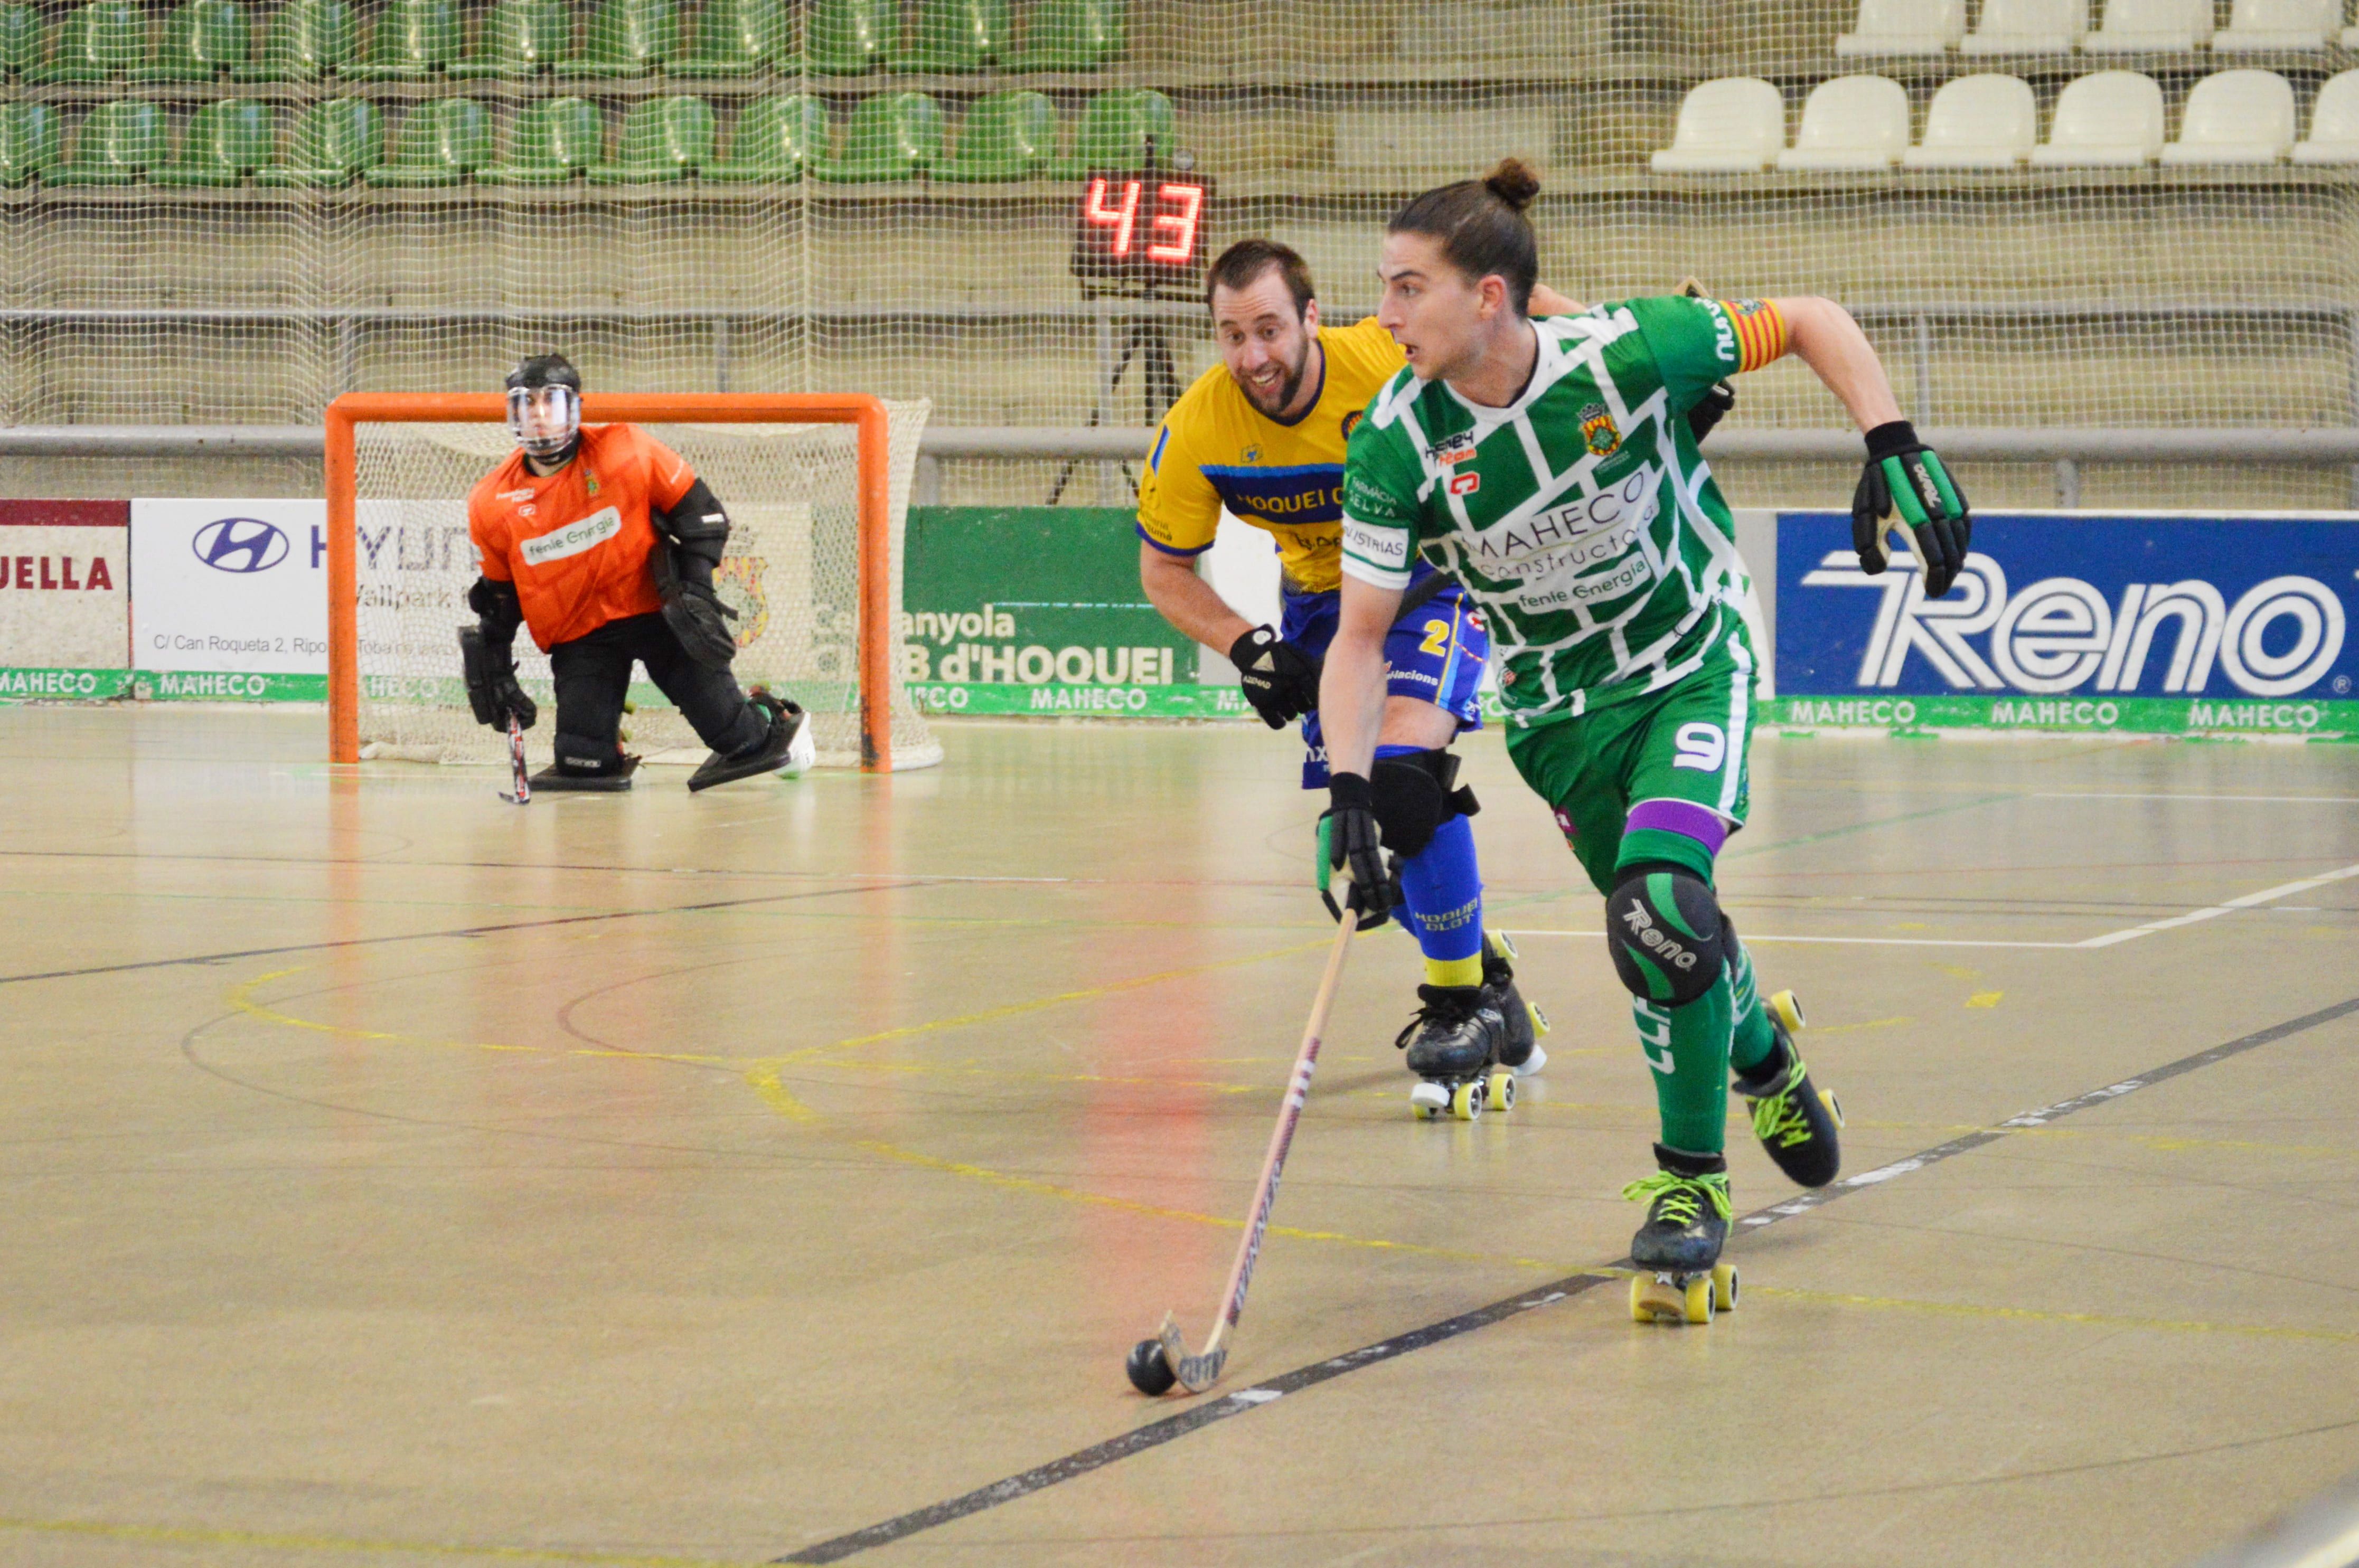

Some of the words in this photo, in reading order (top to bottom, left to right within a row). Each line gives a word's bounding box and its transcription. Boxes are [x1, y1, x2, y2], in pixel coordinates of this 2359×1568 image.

[1085, 178, 1204, 262] 43
[1349, 490, 1395, 517] SELVA
[1801, 550, 2346, 696] Reno
[174, 635, 204, 650] Can
[209, 636, 270, 656] Roqueta
[1420, 619, 1450, 657] 2
[939, 643, 1173, 685] d'HOQUEI
[159, 674, 265, 695] MAHECO
[1030, 687, 1148, 710] MAHECO
[1791, 701, 1916, 724] MAHECO
[1992, 701, 2119, 726] MAHECO
[2189, 704, 2320, 728] MAHECO
[1673, 722, 1726, 772] 9
[1623, 898, 1697, 969] Reno
